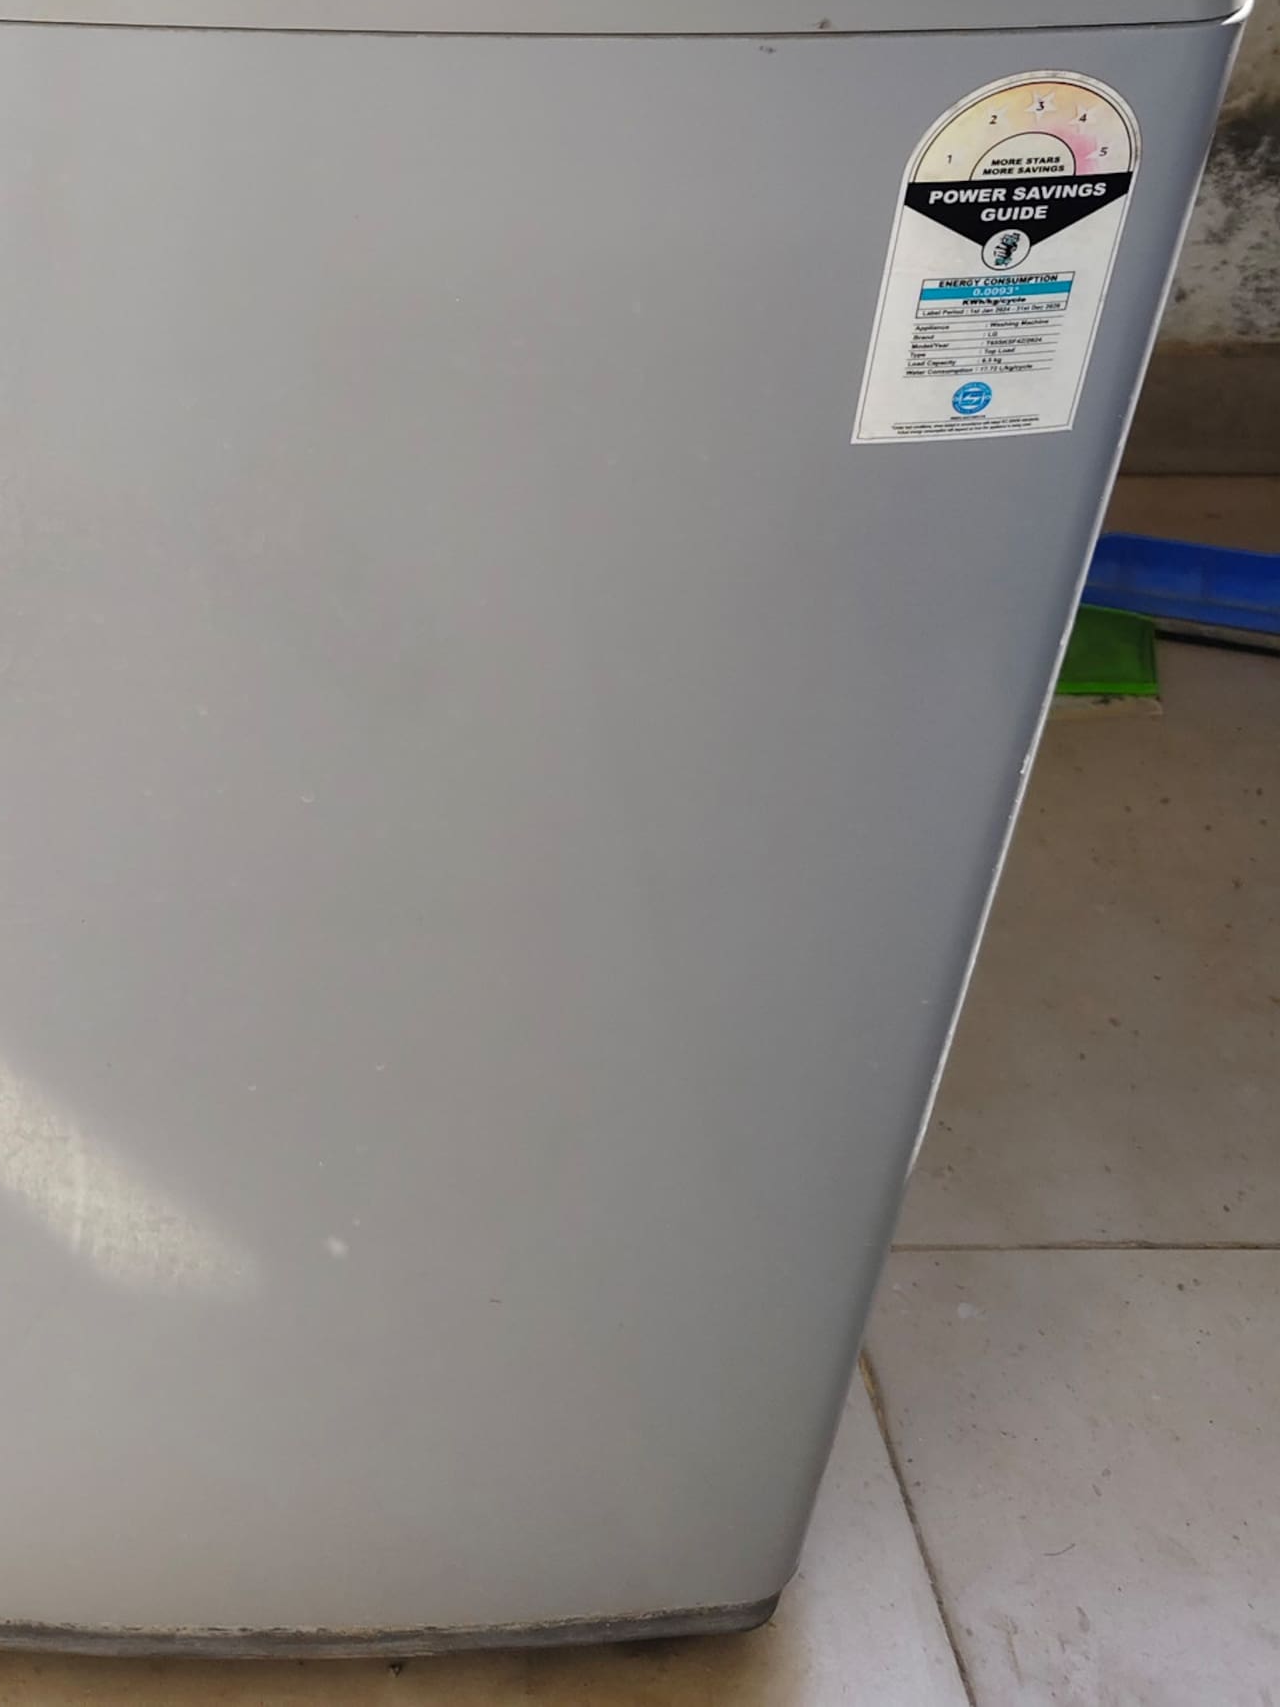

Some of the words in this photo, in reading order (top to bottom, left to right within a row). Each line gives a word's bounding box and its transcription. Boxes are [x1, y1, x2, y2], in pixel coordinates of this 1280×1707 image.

[1036, 101, 1045, 112] 3
[988, 115, 998, 125] 2
[1078, 113, 1088, 123] 4
[1099, 147, 1109, 157] 5
[946, 154, 952, 164] 1
[991, 158, 1022, 166] MORE
[1025, 156, 1061, 165] STARS
[982, 167, 1016, 176] MORE
[1018, 165, 1065, 174] SAVINGS
[928, 188, 1006, 205] POWER
[1012, 182, 1108, 201] SAVINGS
[980, 205, 1049, 222] GUIDE
[938, 278, 980, 288] ENERGY
[983, 274, 1059, 286] CONSUMPTION
